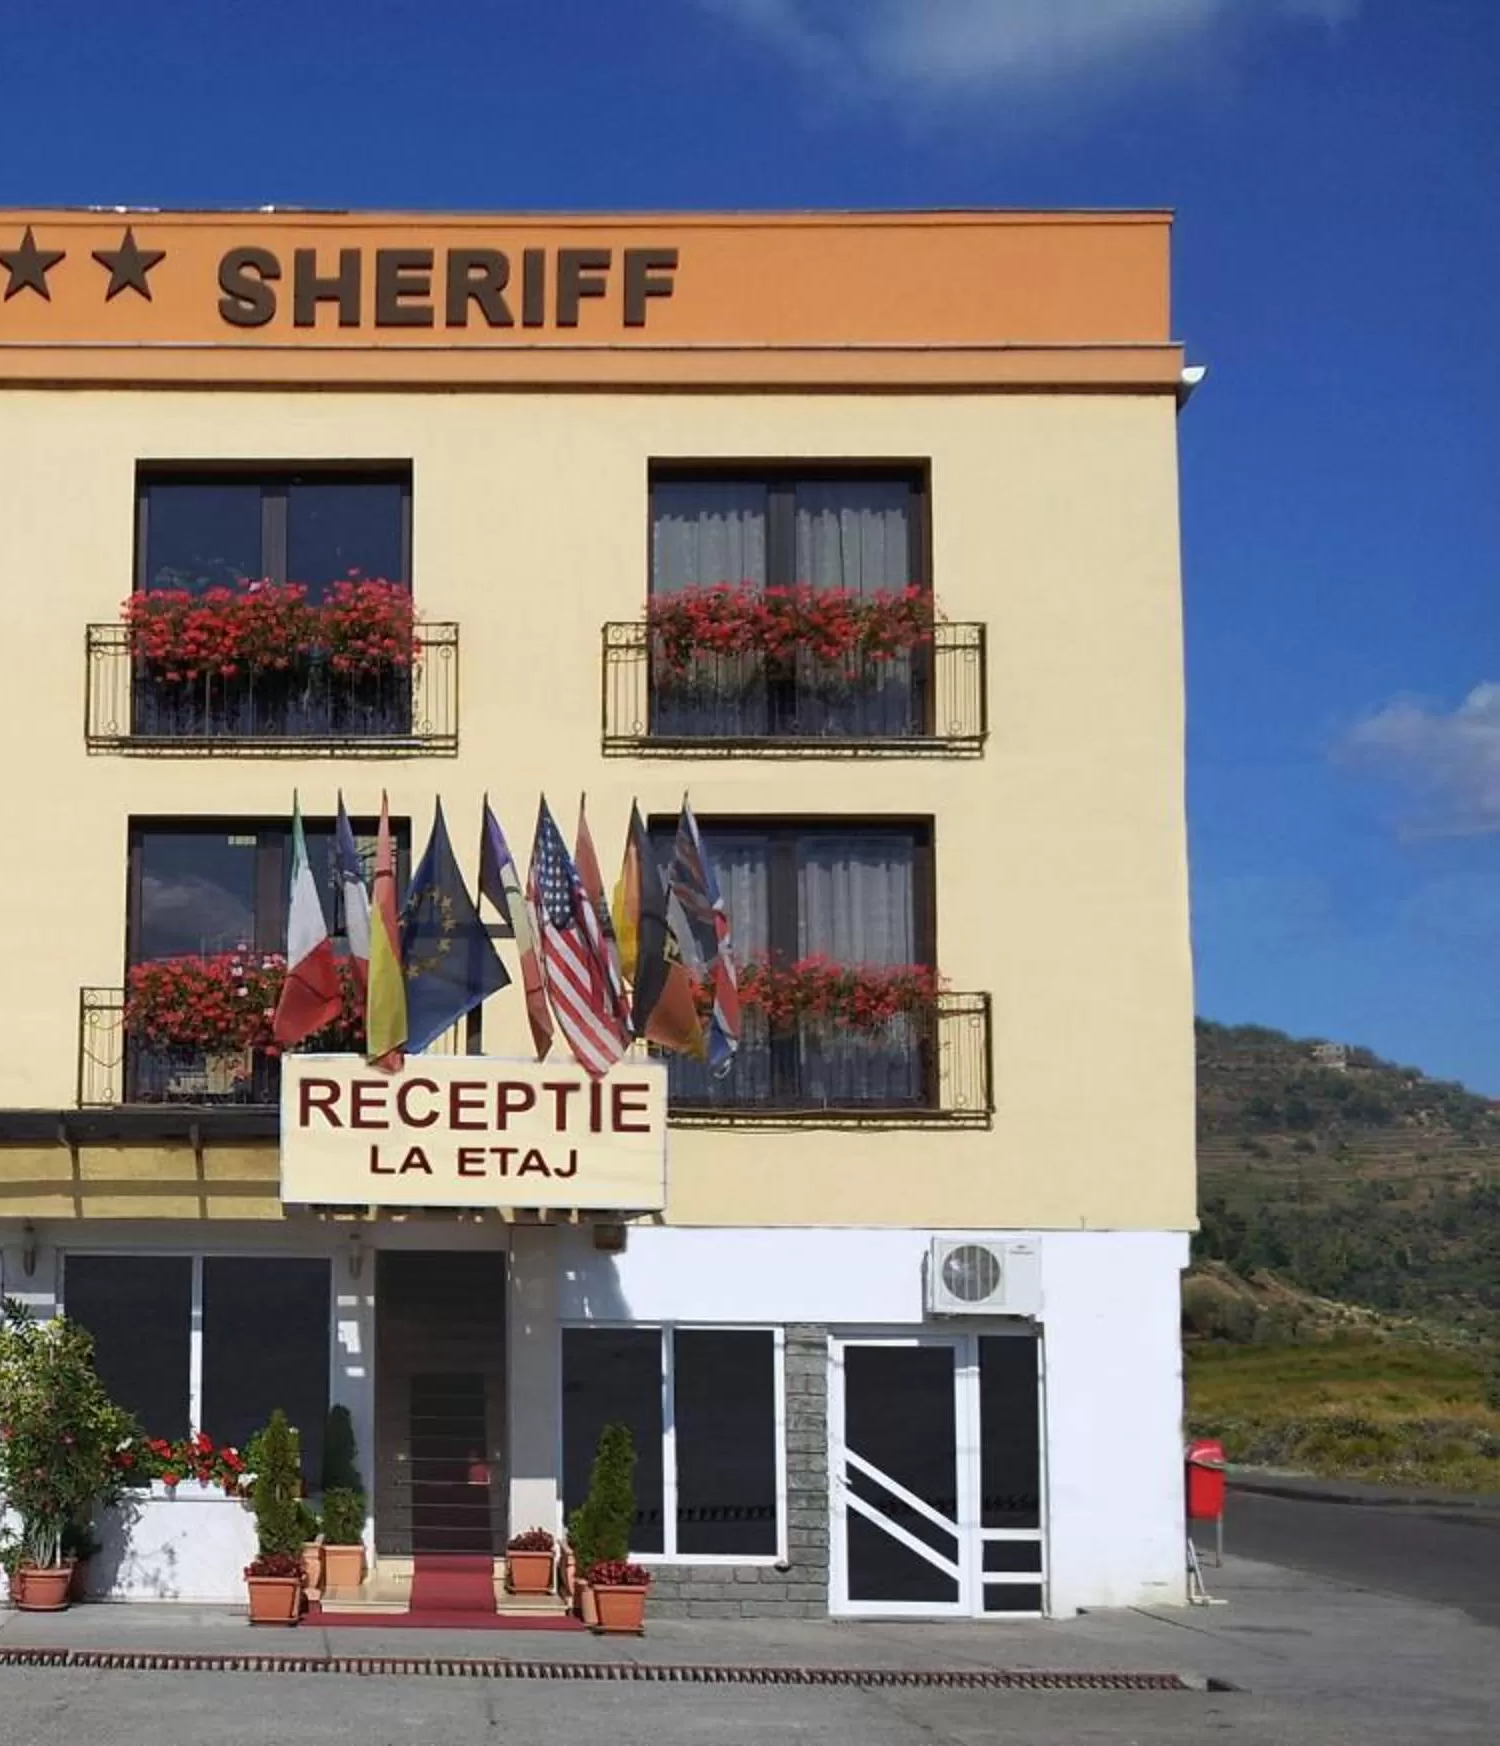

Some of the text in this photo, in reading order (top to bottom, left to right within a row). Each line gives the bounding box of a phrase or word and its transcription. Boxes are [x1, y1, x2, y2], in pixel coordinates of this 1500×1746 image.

[217, 245, 679, 329] SHERIFF
[298, 1077, 652, 1134] RECEPTIE
[369, 1144, 579, 1178] LA ETAJ
